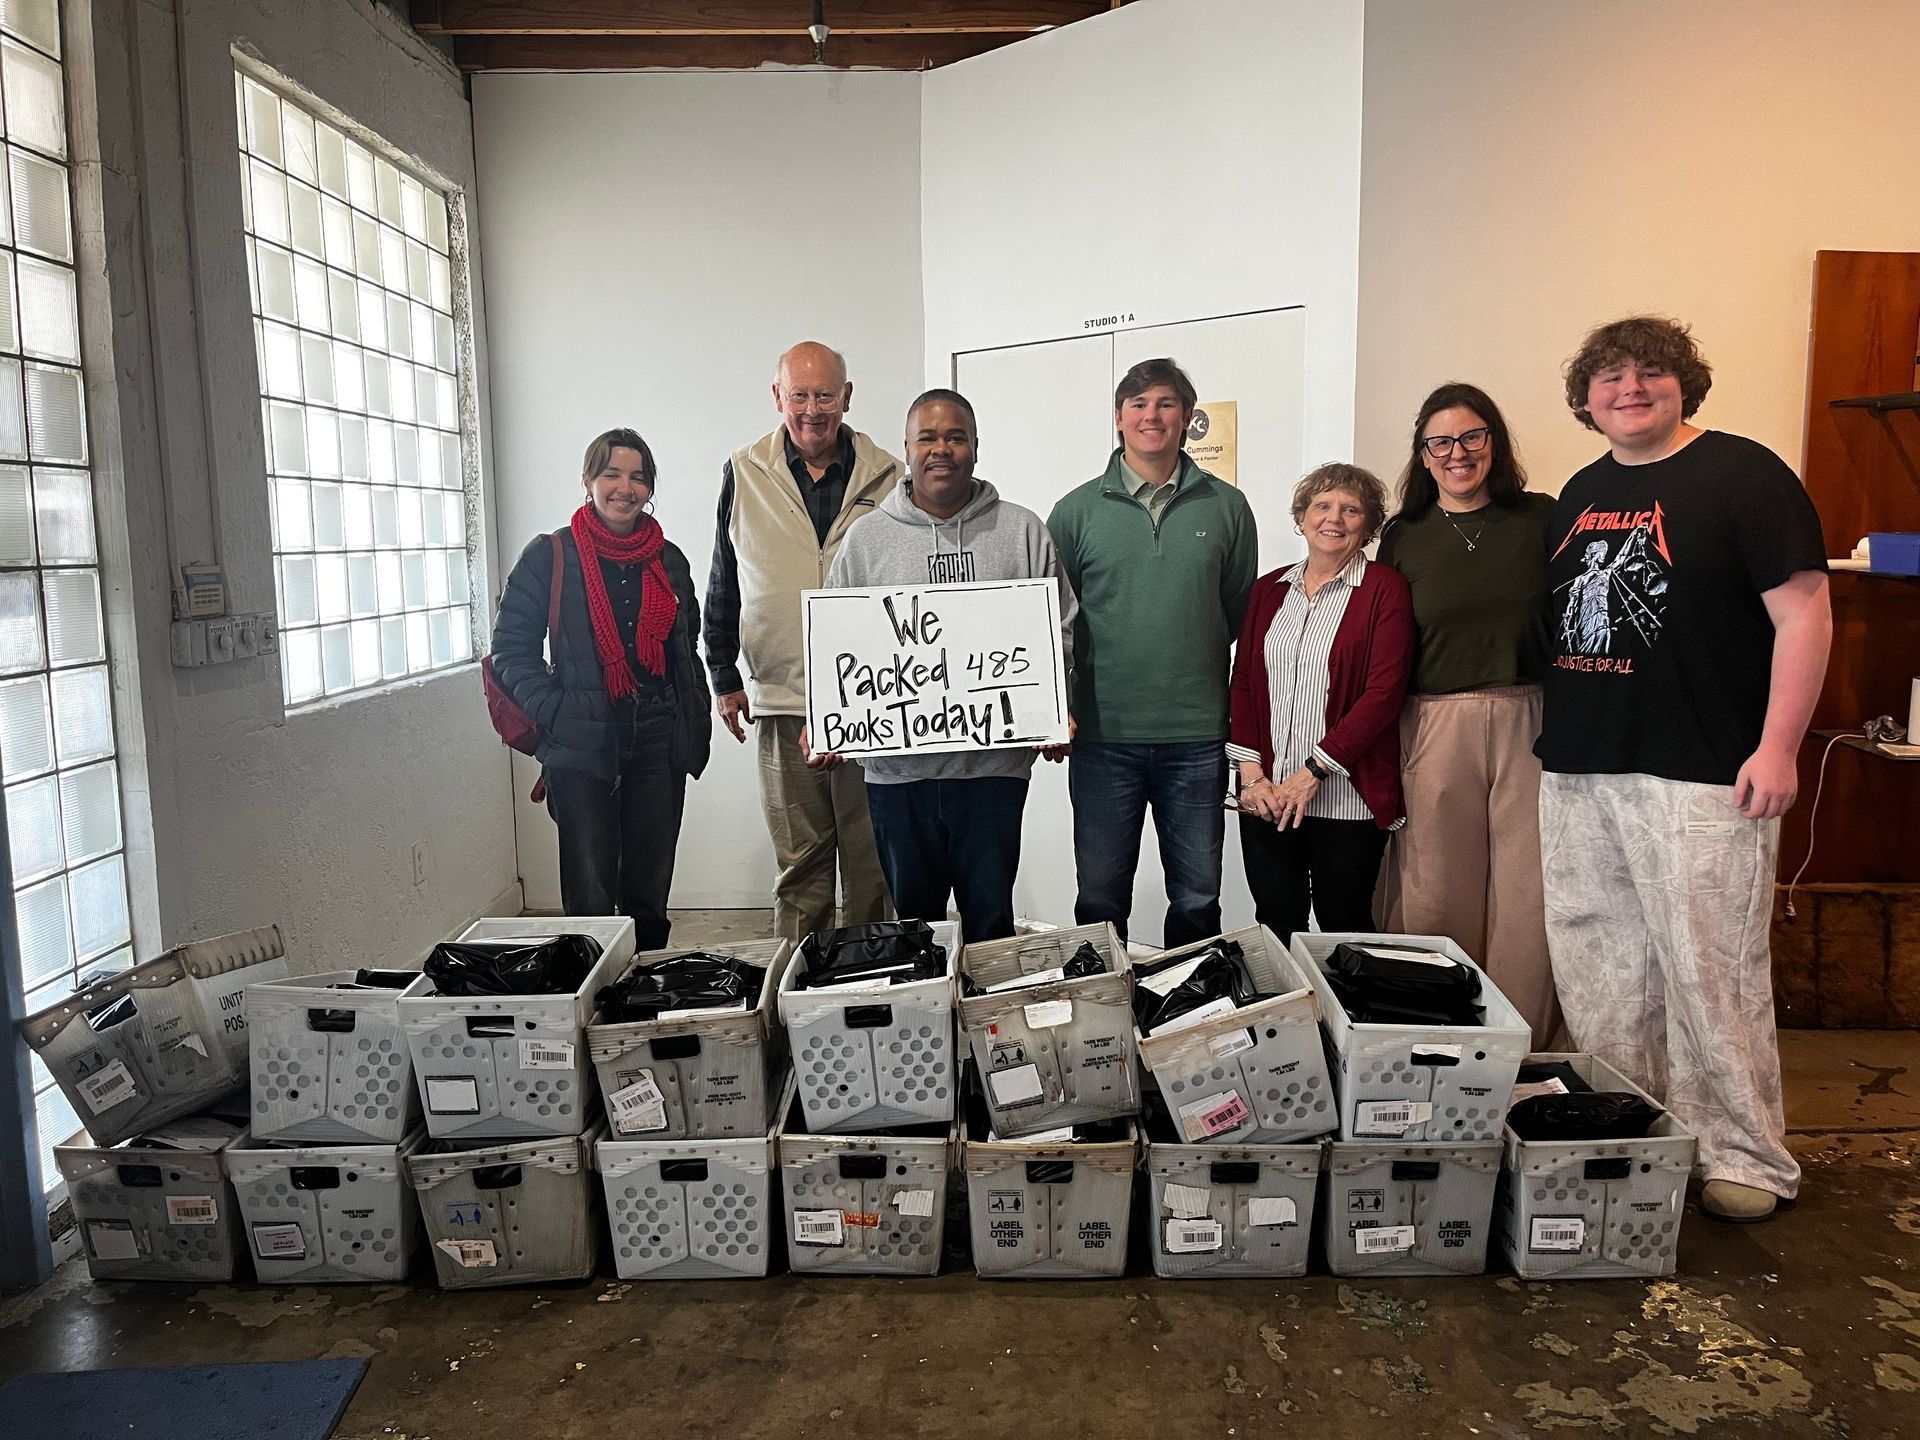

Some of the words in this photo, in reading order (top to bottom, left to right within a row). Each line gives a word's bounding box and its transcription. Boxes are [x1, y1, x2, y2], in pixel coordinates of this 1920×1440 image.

[1084, 315, 1118, 329] STUDIO
[1120, 314, 1125, 323] 1
[1128, 313, 1135, 322] A
[1186, 445, 1224, 454] Cummings
[1549, 499, 1673, 568] METALLICA
[882, 595, 943, 647] We
[1594, 657, 1613, 673] FOR
[1614, 658, 1634, 674] ALL
[835, 647, 950, 708] Packed
[966, 646, 1031, 681] 485
[823, 708, 894, 752] Books
[990, 1220, 1023, 1229] LABEL
[1079, 1222, 1111, 1230] LABEL
[1439, 1220, 1471, 1229] LABEL
[990, 1230, 1024, 1239] OTHER
[1078, 1231, 1111, 1239] OTHER
[1438, 1230, 1472, 1238] OTHER
[997, 1239, 1018, 1247] END
[1084, 1240, 1105, 1248] END
[1443, 1239, 1465, 1247] END
